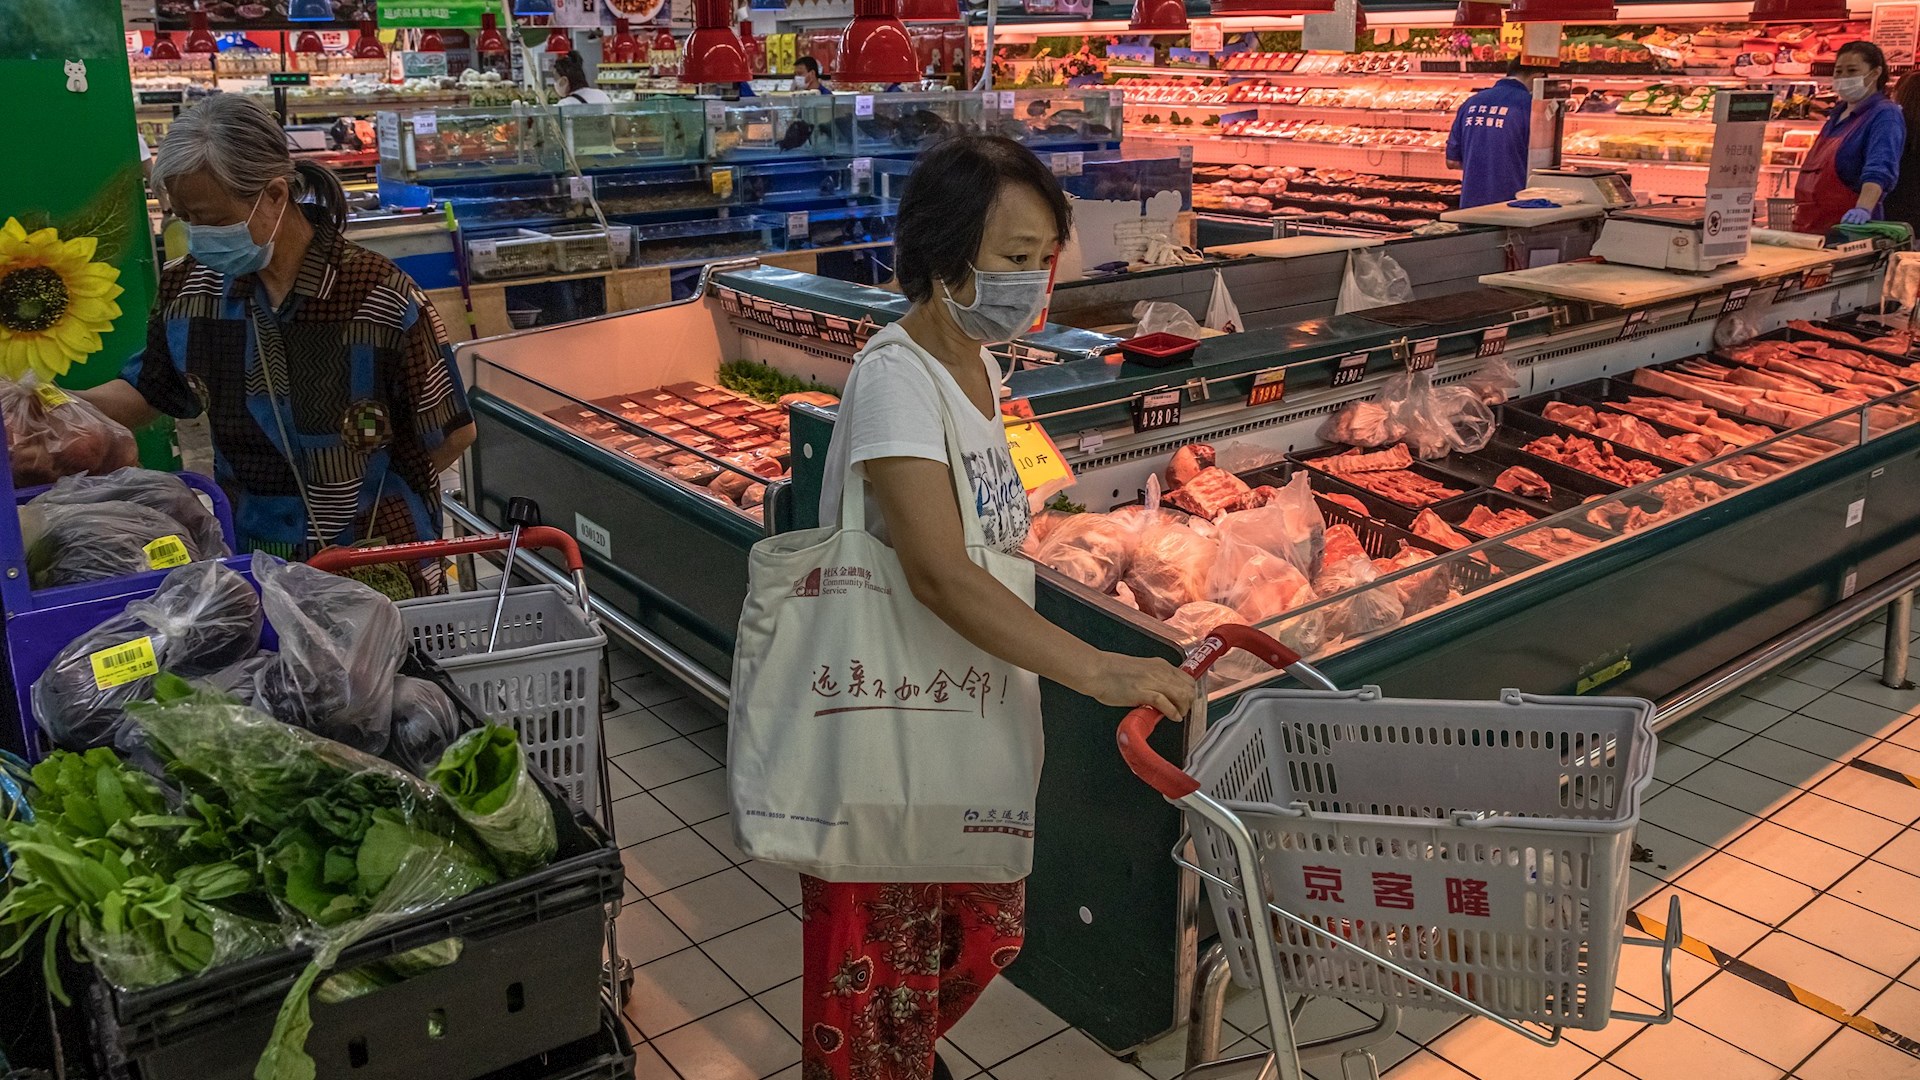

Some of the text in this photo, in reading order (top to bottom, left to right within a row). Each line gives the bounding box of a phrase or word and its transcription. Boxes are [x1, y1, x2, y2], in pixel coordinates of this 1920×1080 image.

[823, 566, 872, 581] 社区金融服务
[821, 586, 847, 595] Service
[822, 579, 892, 596] Community Financial
[790, 814, 849, 827] www.bankcomm.com
[1302, 865, 1491, 917] 京客隆
